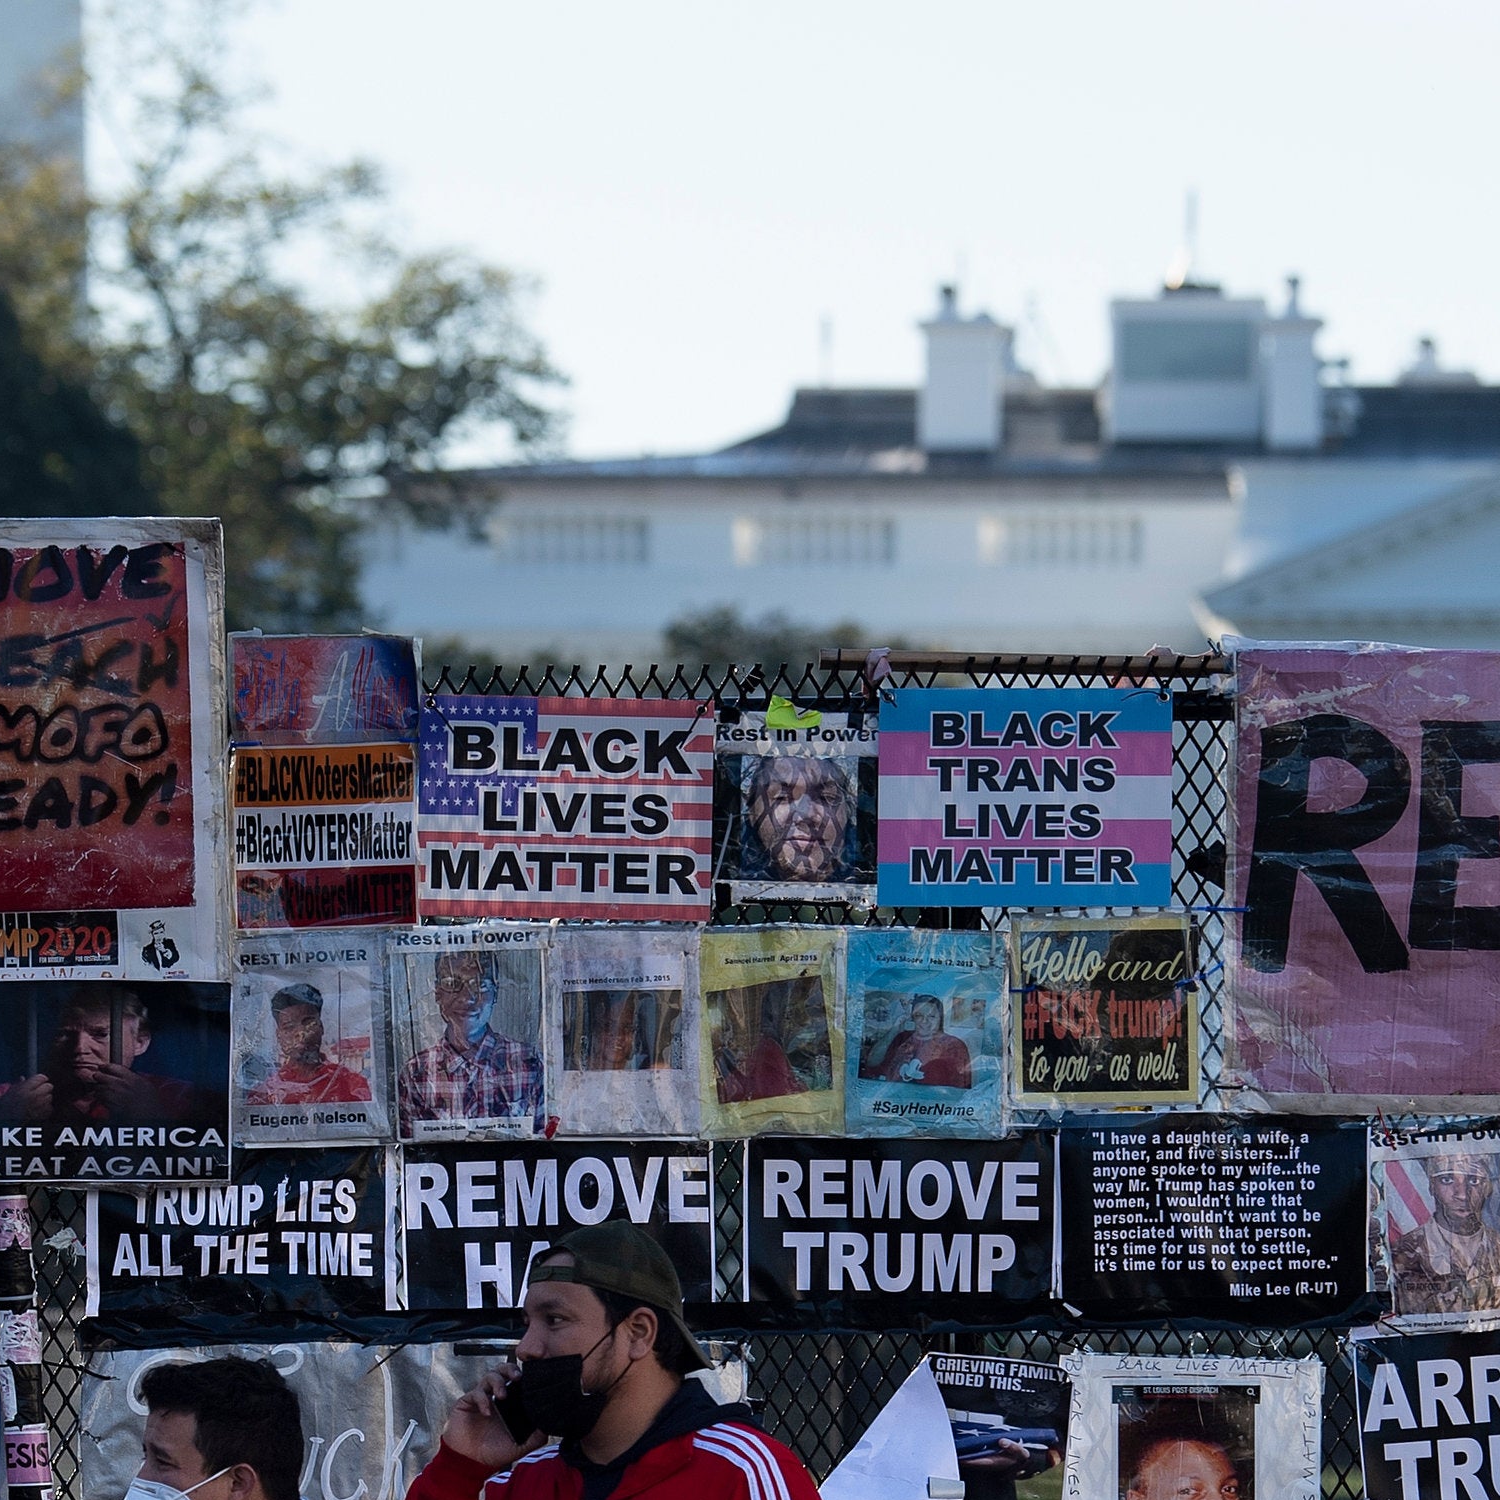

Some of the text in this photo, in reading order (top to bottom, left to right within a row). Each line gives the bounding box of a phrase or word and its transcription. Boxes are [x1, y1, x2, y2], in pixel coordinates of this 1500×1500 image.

[451, 726, 694, 775] BLACK
[929, 711, 1118, 749] BLACK
[236, 753, 413, 803] #BLACKVotersMatter
[927, 756, 1116, 794] TRANS
[236, 810, 412, 864] #BlackVOTERSMatter
[482, 795, 670, 836] LIVES
[943, 802, 1104, 839] LIVES
[429, 849, 698, 895] MATTER
[909, 848, 1136, 886] MATTER
[1022, 936, 1184, 984] Hello and
[1024, 989, 1182, 1050] #FUCK trump!
[1029, 1045, 1050, 1082] to
[1054, 1053, 1090, 1091] you
[1110, 1053, 1131, 1081] as
[1137, 1042, 1179, 1081] well.
[55, 1128, 224, 1146] AMERICA
[78, 1156, 214, 1176] AGAIN!
[762, 1158, 1040, 1221] REMOVE
[782, 1233, 1016, 1292] TRUMP
[1094, 1258, 1117, 1272] it's
[1123, 1257, 1155, 1271] time
[1161, 1257, 1186, 1270] for
[1188, 1260, 1205, 1270] us
[1211, 1258, 1226, 1270] to
[1231, 1257, 1283, 1272] expect
[1230, 1282, 1338, 1297] Mike Lee (R-UT)
